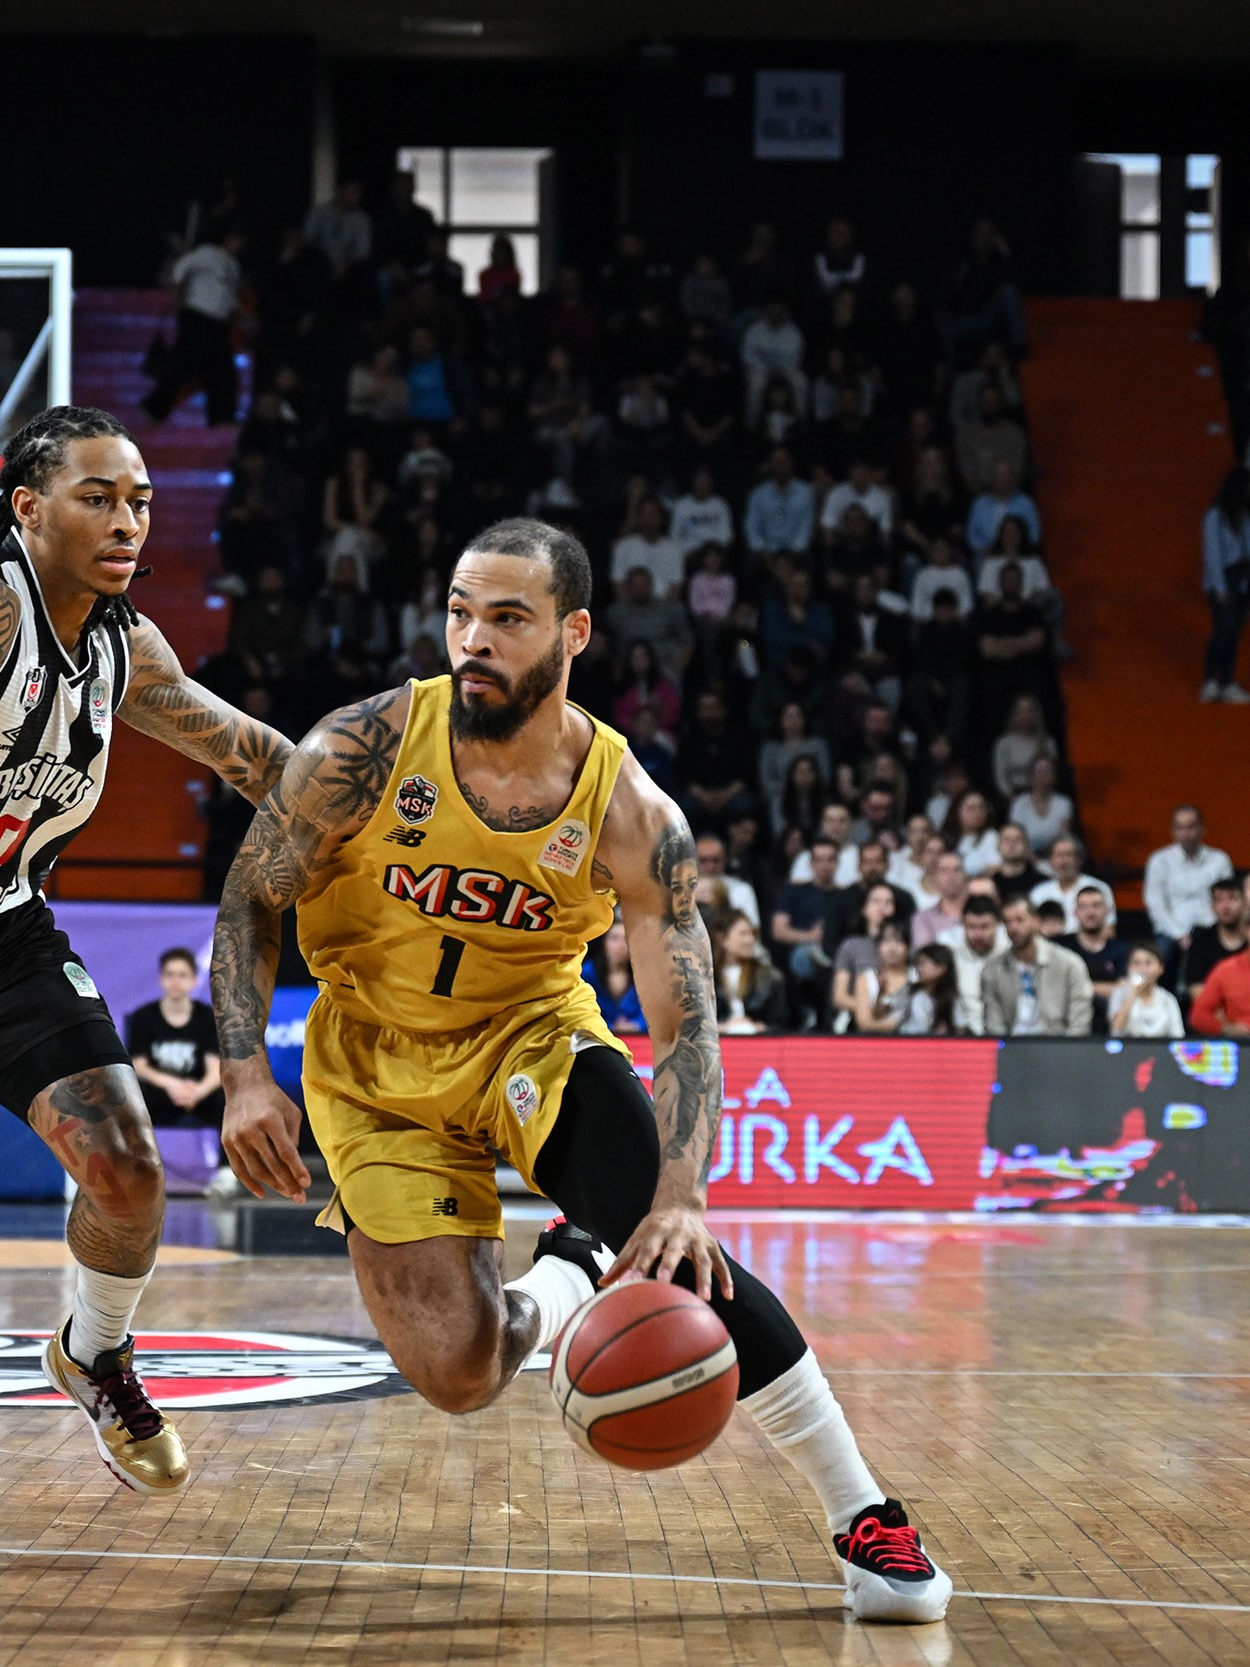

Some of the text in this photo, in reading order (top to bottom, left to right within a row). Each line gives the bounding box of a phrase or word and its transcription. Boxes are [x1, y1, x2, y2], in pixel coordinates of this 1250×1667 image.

[397, 797, 432, 816] MSK
[385, 865, 554, 930] MSK
[429, 935, 466, 997] 1
